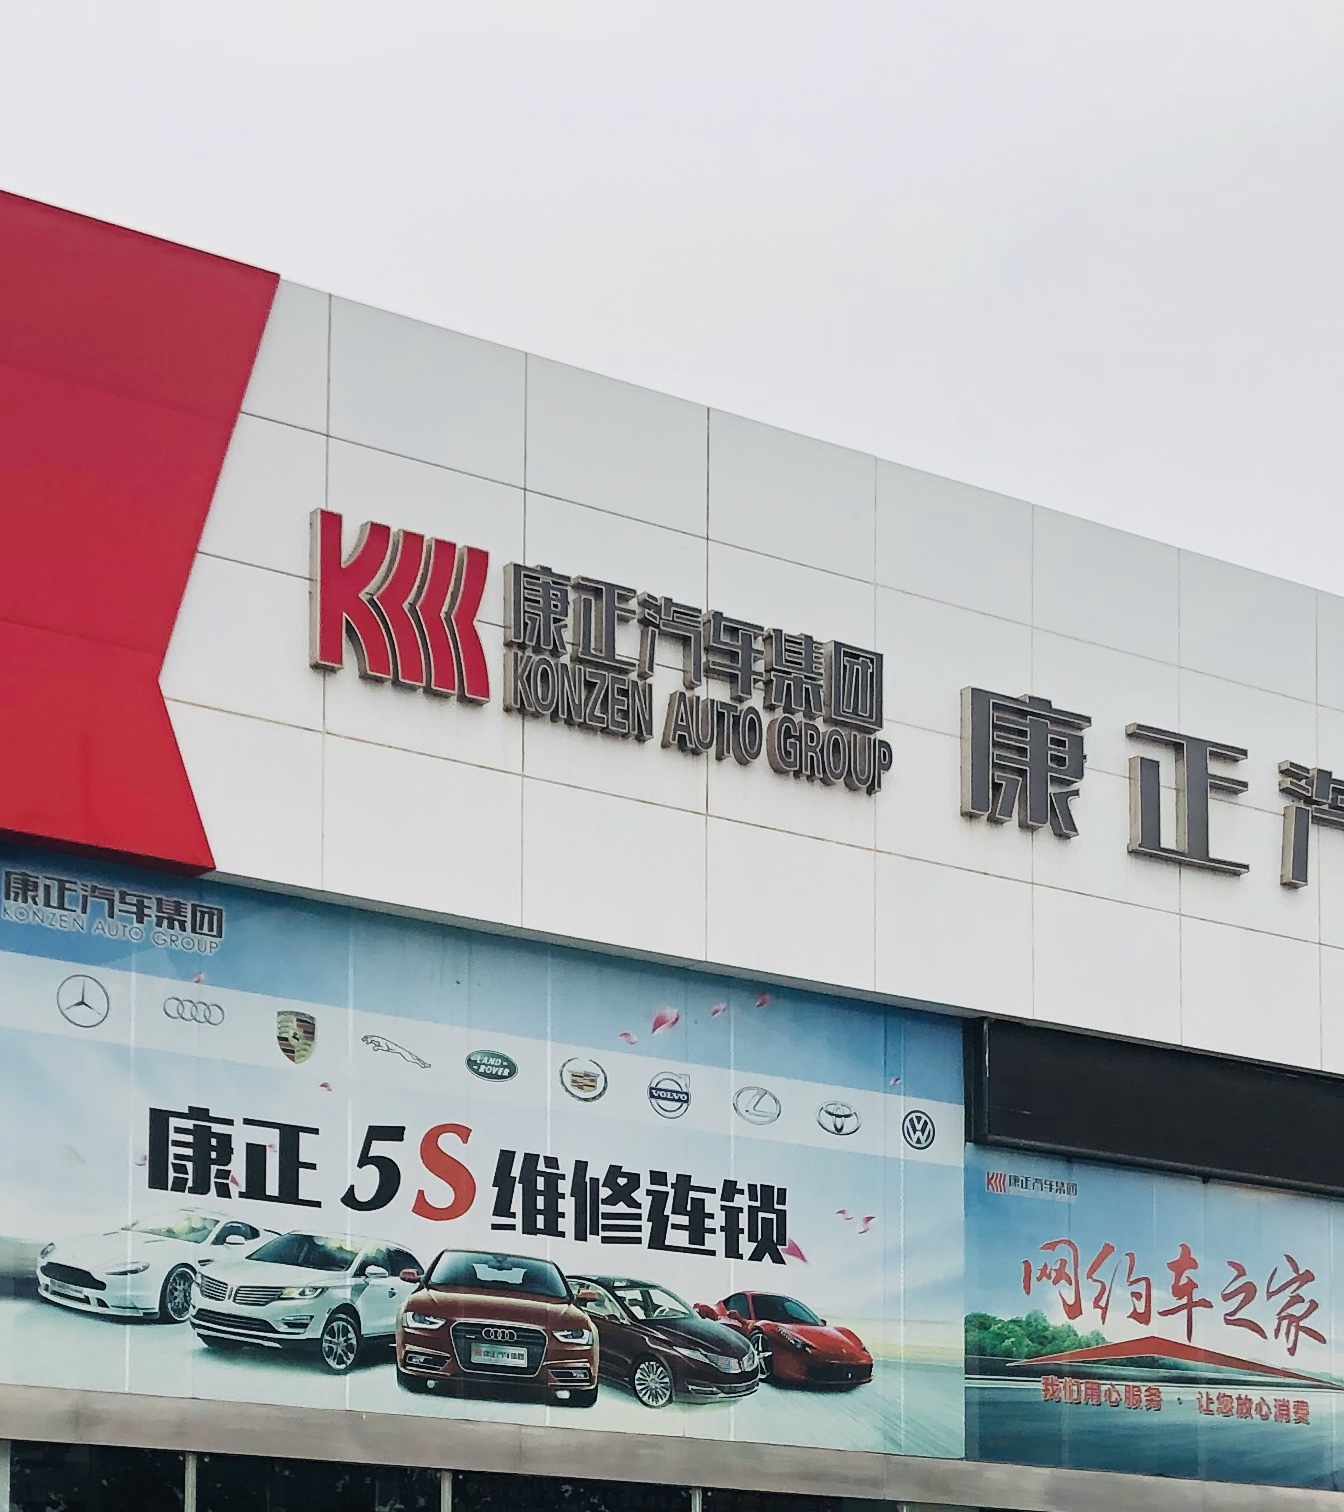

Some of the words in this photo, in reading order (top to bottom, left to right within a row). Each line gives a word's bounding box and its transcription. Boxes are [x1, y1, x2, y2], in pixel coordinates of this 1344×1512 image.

[503, 562, 883, 733] 康正汽车集团
[503, 650, 653, 741] KONZEN
[662, 691, 763, 766] AUTO
[767, 717, 893, 796] GROUP
[3, 906, 86, 932] KONZEN
[94, 923, 144, 942] AUTO
[152, 931, 220, 953] GROUP
[5, 870, 223, 939] 康正汽车集团
[475, 1055, 502, 1067] LAND
[478, 1065, 510, 1077] ROVER
[651, 1089, 688, 1101] VOLVO
[1021, 1239, 1327, 1357] 网约车之家
[1041, 1375, 1163, 1412] 我们用心服务
[1196, 1391, 1312, 1425] 让您放心消费
